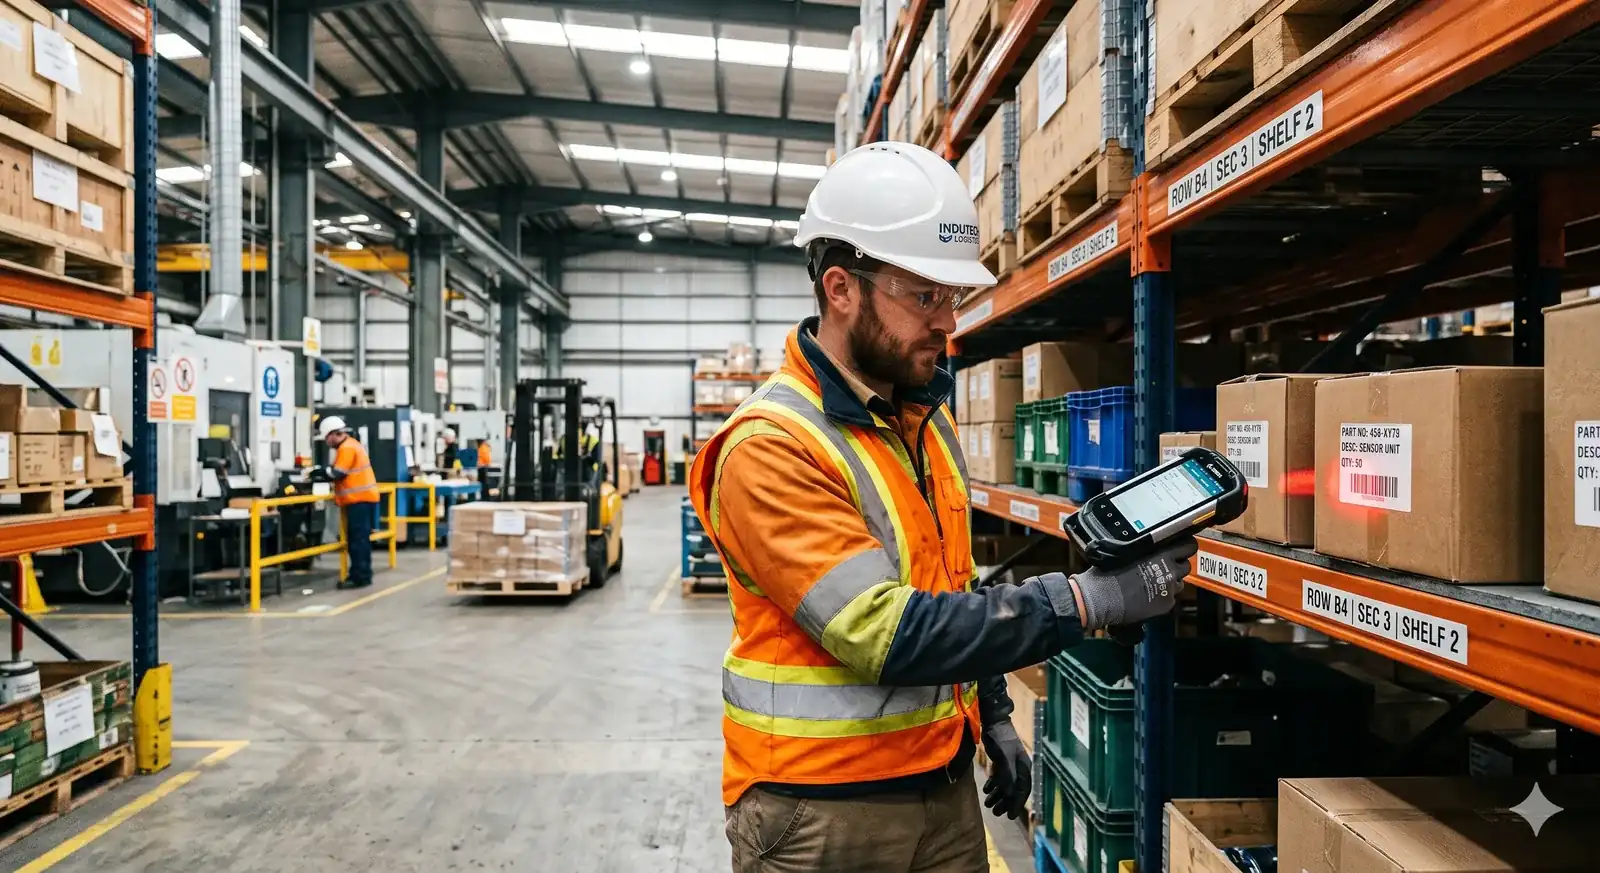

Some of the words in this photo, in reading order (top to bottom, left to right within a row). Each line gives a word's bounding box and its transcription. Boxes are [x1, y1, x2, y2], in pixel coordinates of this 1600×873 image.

[1172, 178, 1192, 207] ROW
[1195, 169, 1207, 193] B4
[1216, 150, 1238, 181] SEC
[1241, 145, 1248, 167] 3
[1258, 109, 1302, 157] SHELF
[1305, 103, 1314, 131] 2
[1089, 229, 1109, 255] SHELF
[1110, 227, 1115, 244] 2
[1341, 427, 1356, 437] PART
[1357, 427, 1368, 437] NO:
[1577, 426, 1600, 438] PART
[1341, 442, 1358, 452] DESC:
[1359, 442, 1384, 453] SENSOR
[1384, 444, 1400, 454] UNIT
[1577, 446, 1600, 458] DESC
[1341, 457, 1354, 468] QTY:
[1355, 458, 1363, 468] 50
[1577, 466, 1598, 480] QTY:
[1200, 556, 1217, 574] ROW
[1218, 560, 1228, 578] B4
[1233, 566, 1249, 585] SEC
[1250, 572, 1256, 588] 3
[1257, 574, 1263, 591] 2
[1307, 587, 1331, 612] ROW
[1334, 597, 1348, 617] B4
[1358, 602, 1380, 627] SEC
[1383, 610, 1391, 631] 3
[1402, 615, 1446, 648] SHELF
[1450, 630, 1459, 653] 2
